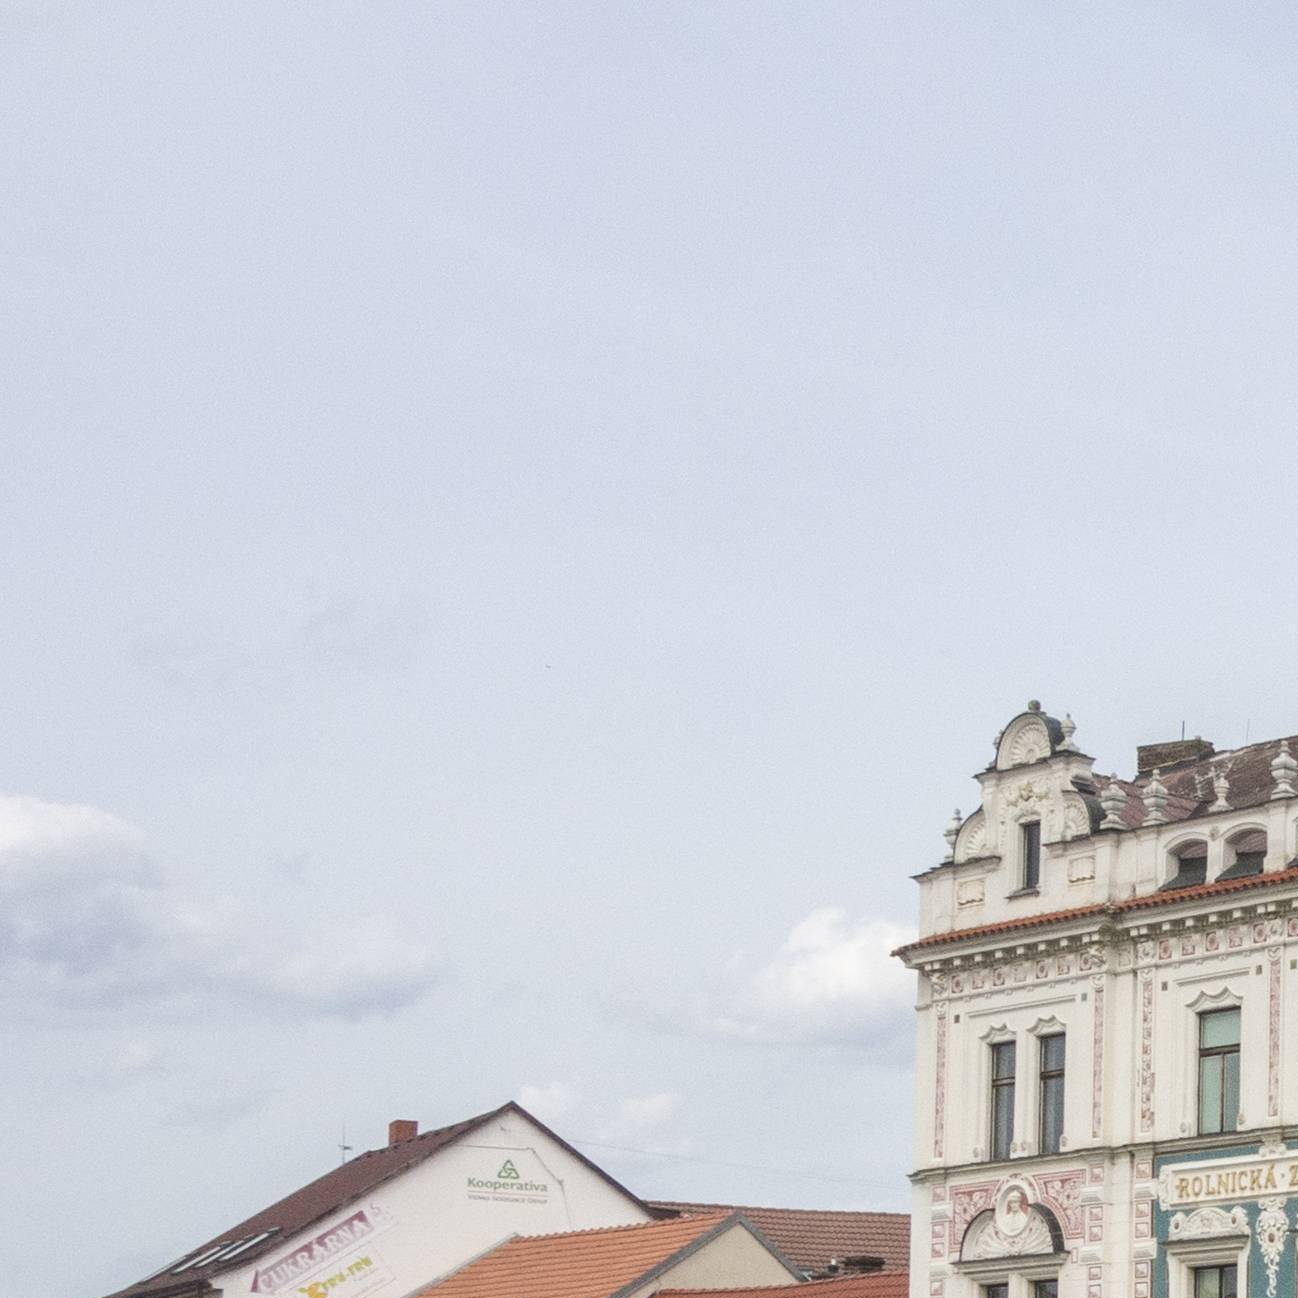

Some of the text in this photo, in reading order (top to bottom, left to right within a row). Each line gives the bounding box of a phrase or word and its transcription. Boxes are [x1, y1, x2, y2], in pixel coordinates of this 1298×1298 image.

[467, 1177, 548, 1193] Kooperativa
[1177, 1162, 1278, 1199] ROLNICKÁ
[260, 1217, 372, 1290] CUKRÁRNA
